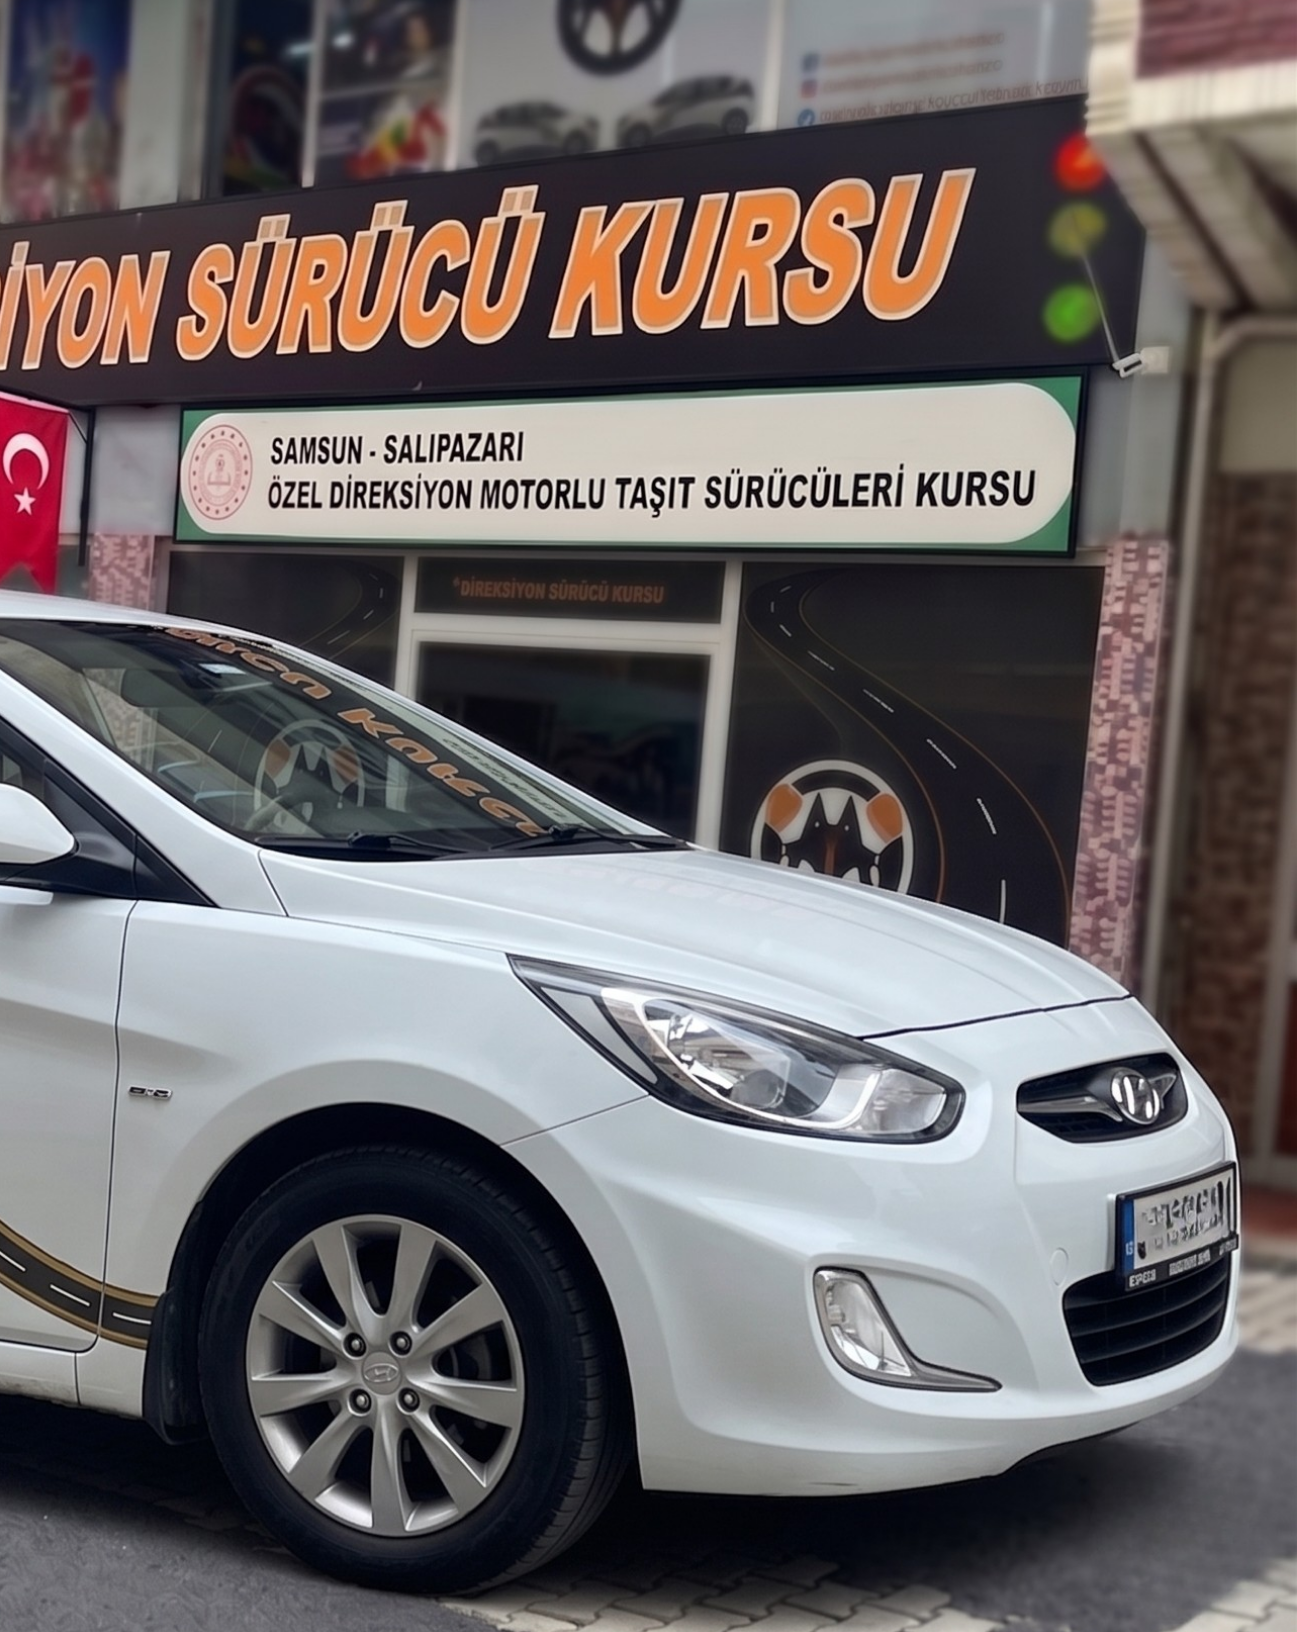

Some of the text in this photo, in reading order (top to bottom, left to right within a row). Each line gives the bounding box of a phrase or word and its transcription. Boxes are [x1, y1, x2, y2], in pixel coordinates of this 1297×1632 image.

[177, 185, 545, 361] SÜRÜCÜ
[549, 167, 976, 339] KURSU
[270, 436, 363, 465] SAMSUN
[383, 431, 525, 464] SALIPAZARI
[268, 463, 1036, 518] ÖZEL DİREKSİYON MOTORLU TAŞIT SÜRÜCÜLERİ KURSU
[548, 579, 609, 602] SÜRÜCÜ
[612, 585, 665, 604] KURSU
